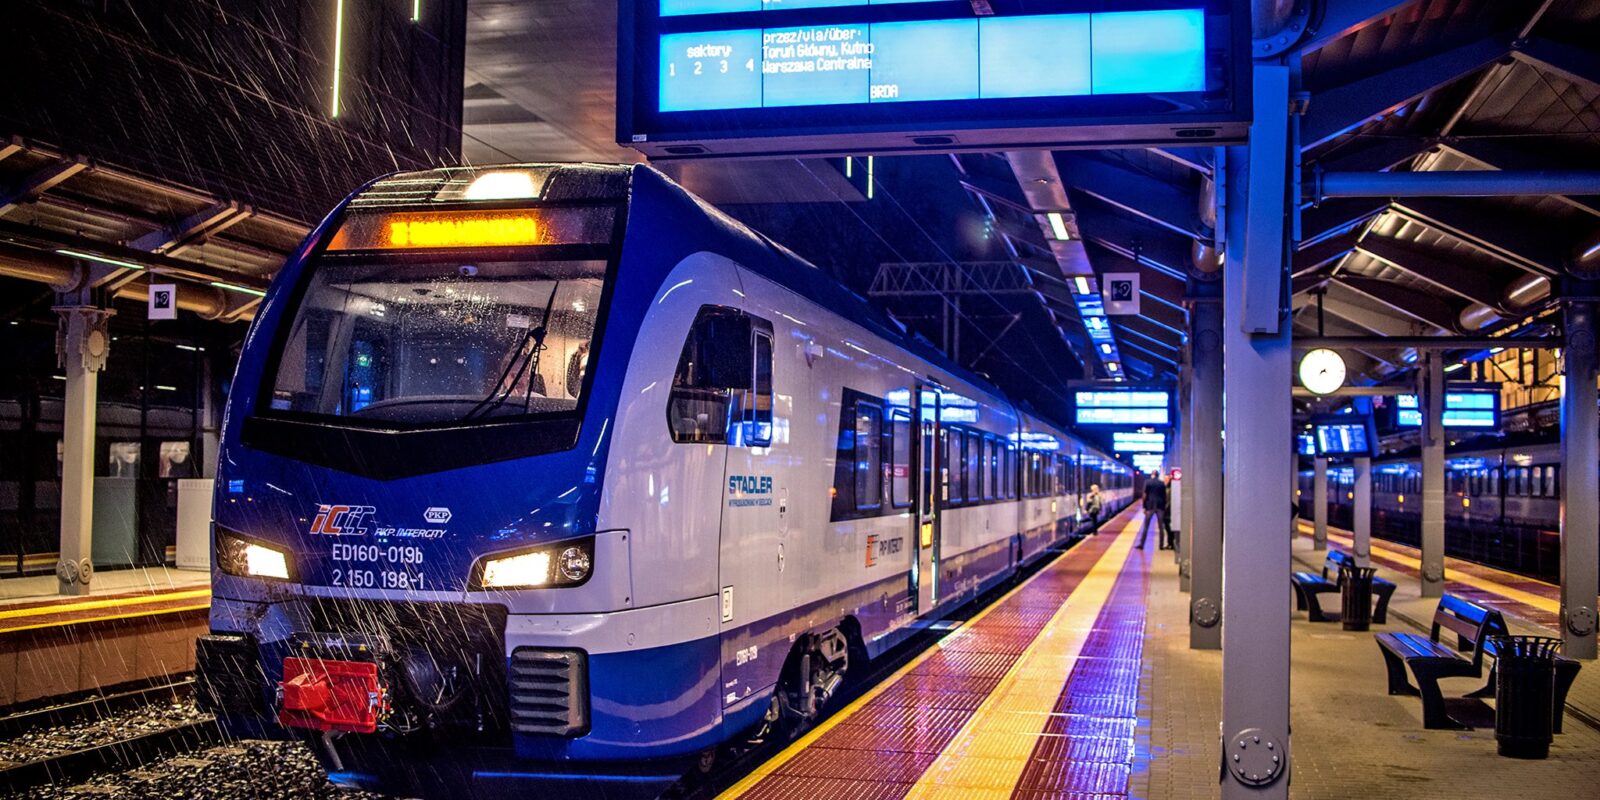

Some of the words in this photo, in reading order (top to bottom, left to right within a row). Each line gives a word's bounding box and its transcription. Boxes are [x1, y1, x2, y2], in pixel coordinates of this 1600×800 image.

[841, 41, 875, 56] Kutno
[669, 62, 676, 77] 1
[693, 60, 703, 75] 2
[719, 59, 729, 74] 3
[745, 58, 755, 73] 4
[762, 60, 815, 74] Warszawa
[816, 56, 873, 72] Centralna
[870, 84, 899, 99] BRDA
[728, 475, 773, 494] STADLER
[428, 511, 449, 519] PKP
[396, 528, 447, 538] INTERCITY
[332, 543, 424, 564] ED160-019b
[332, 569, 342, 586] 2
[347, 570, 374, 588] 150
[381, 571, 424, 589] 198-1
